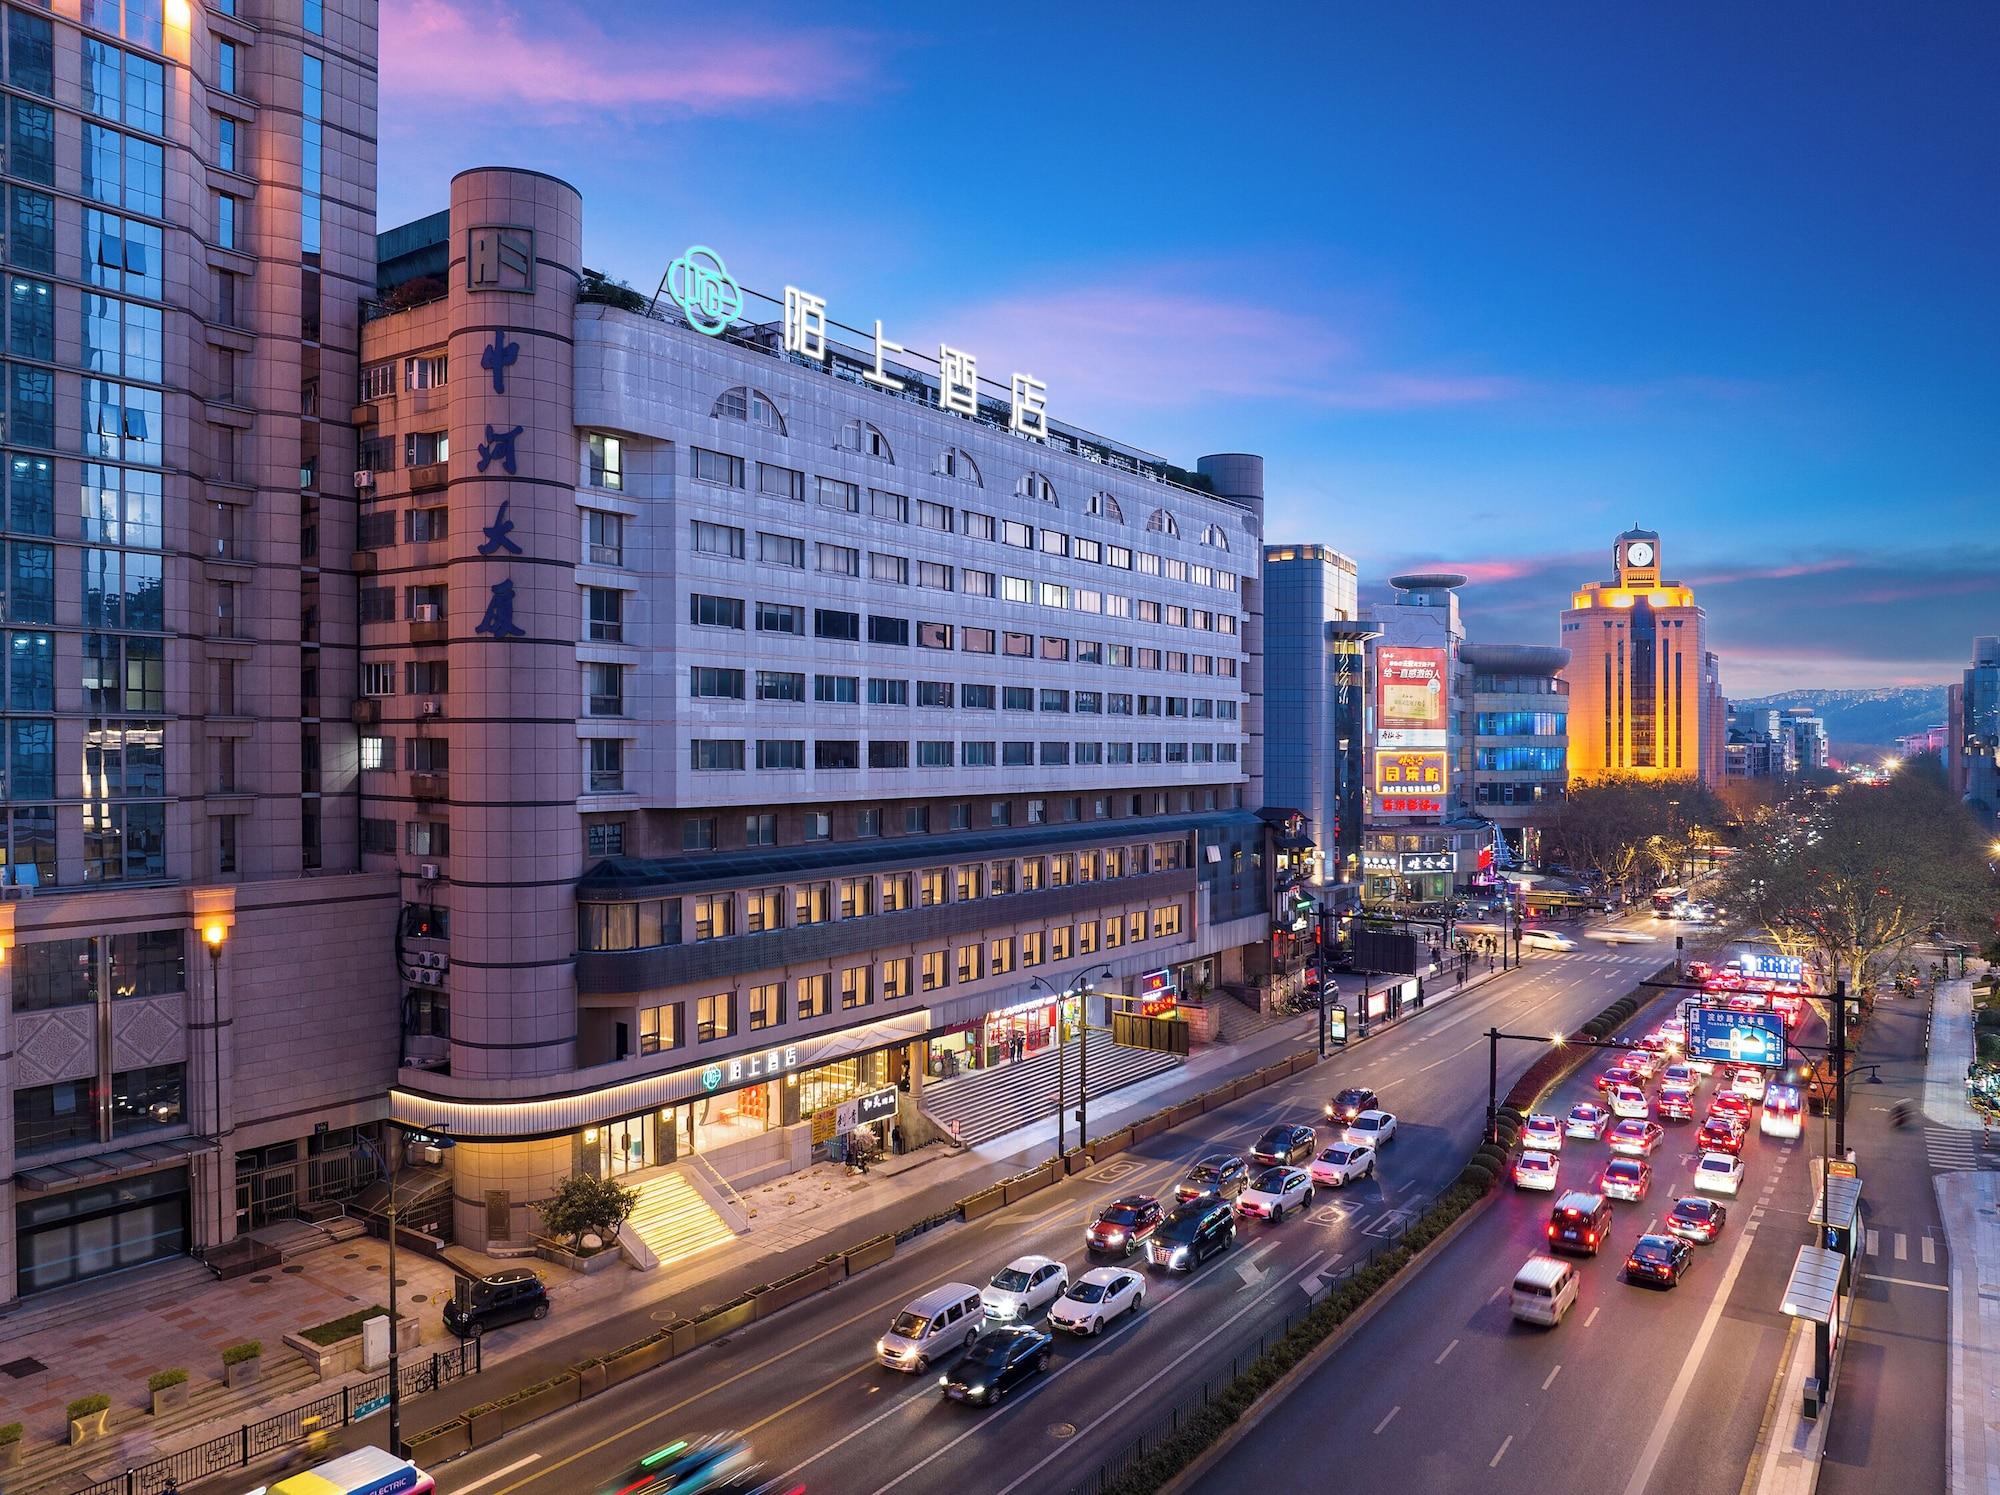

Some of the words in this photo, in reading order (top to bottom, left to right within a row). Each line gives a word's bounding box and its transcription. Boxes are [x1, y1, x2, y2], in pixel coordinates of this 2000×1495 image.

[783, 285, 1049, 440] 陌上酒店
[475, 329, 527, 639] 中河大厦
[1383, 667, 1441, 679] 给一直感激的人
[1407, 857, 1450, 870] 娃哈哈
[729, 1046, 797, 1082] 陌上酒店
